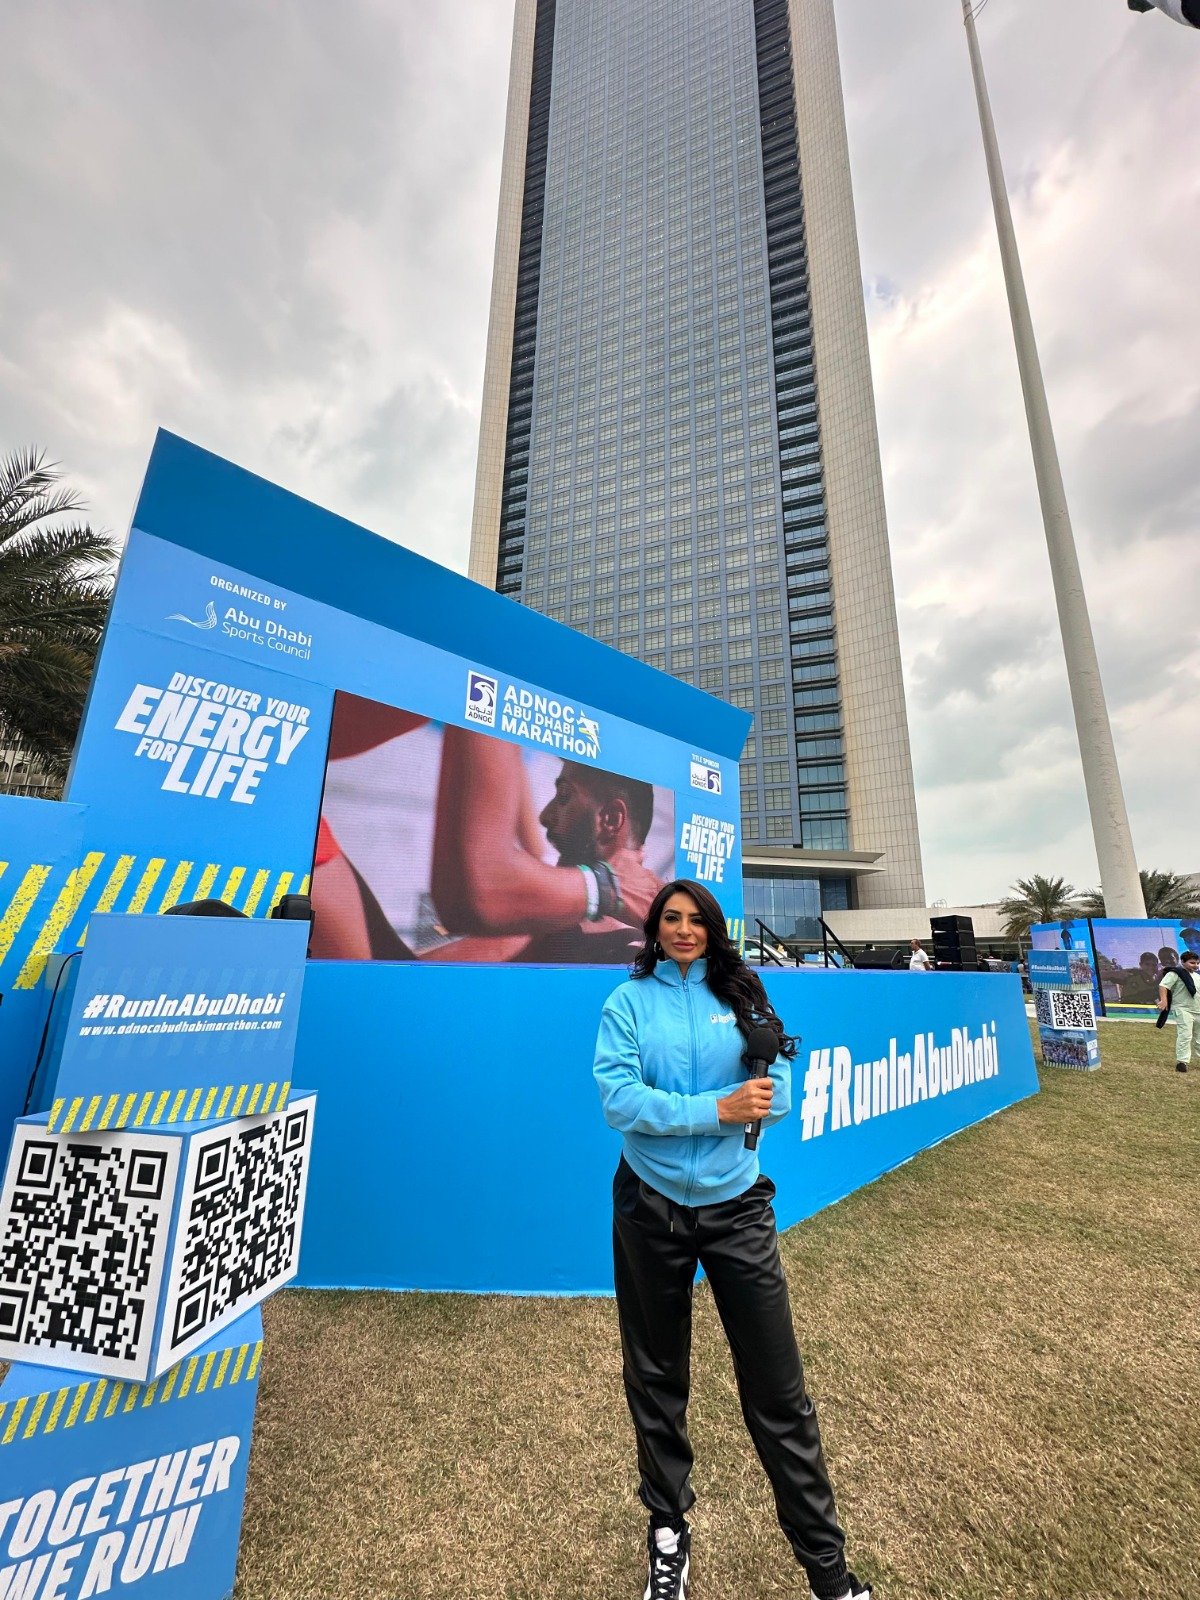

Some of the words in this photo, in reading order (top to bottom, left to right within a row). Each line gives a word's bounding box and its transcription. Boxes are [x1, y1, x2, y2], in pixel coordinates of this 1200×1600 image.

[210, 575, 271, 606] ORGANIZED
[273, 599, 287, 611] BY
[221, 621, 265, 645] Sports
[267, 636, 311, 660] Council
[224, 607, 260, 630] Abu
[265, 620, 312, 647] Dhabi
[167, 672, 262, 713] DISCOVER
[265, 697, 310, 725] YOUR
[468, 711, 492, 724] ADNOC
[503, 684, 575, 724] ADNOC
[114, 684, 310, 765] ENERGY
[501, 715, 597, 759] MARATHON
[502, 702, 532, 722] ABU
[534, 714, 575, 736] DHABI
[134, 736, 179, 763] FOR
[160, 744, 268, 805] LIFE
[680, 822, 736, 860] ENERGY
[691, 813, 720, 831] DISCOVER
[720, 820, 735, 835] YOUR
[686, 851, 699, 864] FOR
[695, 853, 725, 883] LIFE
[82, 992, 286, 1019] #RunInAbuDhabi
[79, 1019, 282, 1037] www.adnocabudhabimarathon.com
[800, 1020, 999, 1142] #RunInAbuDhabi
[77, 1502, 203, 1600] RUN
